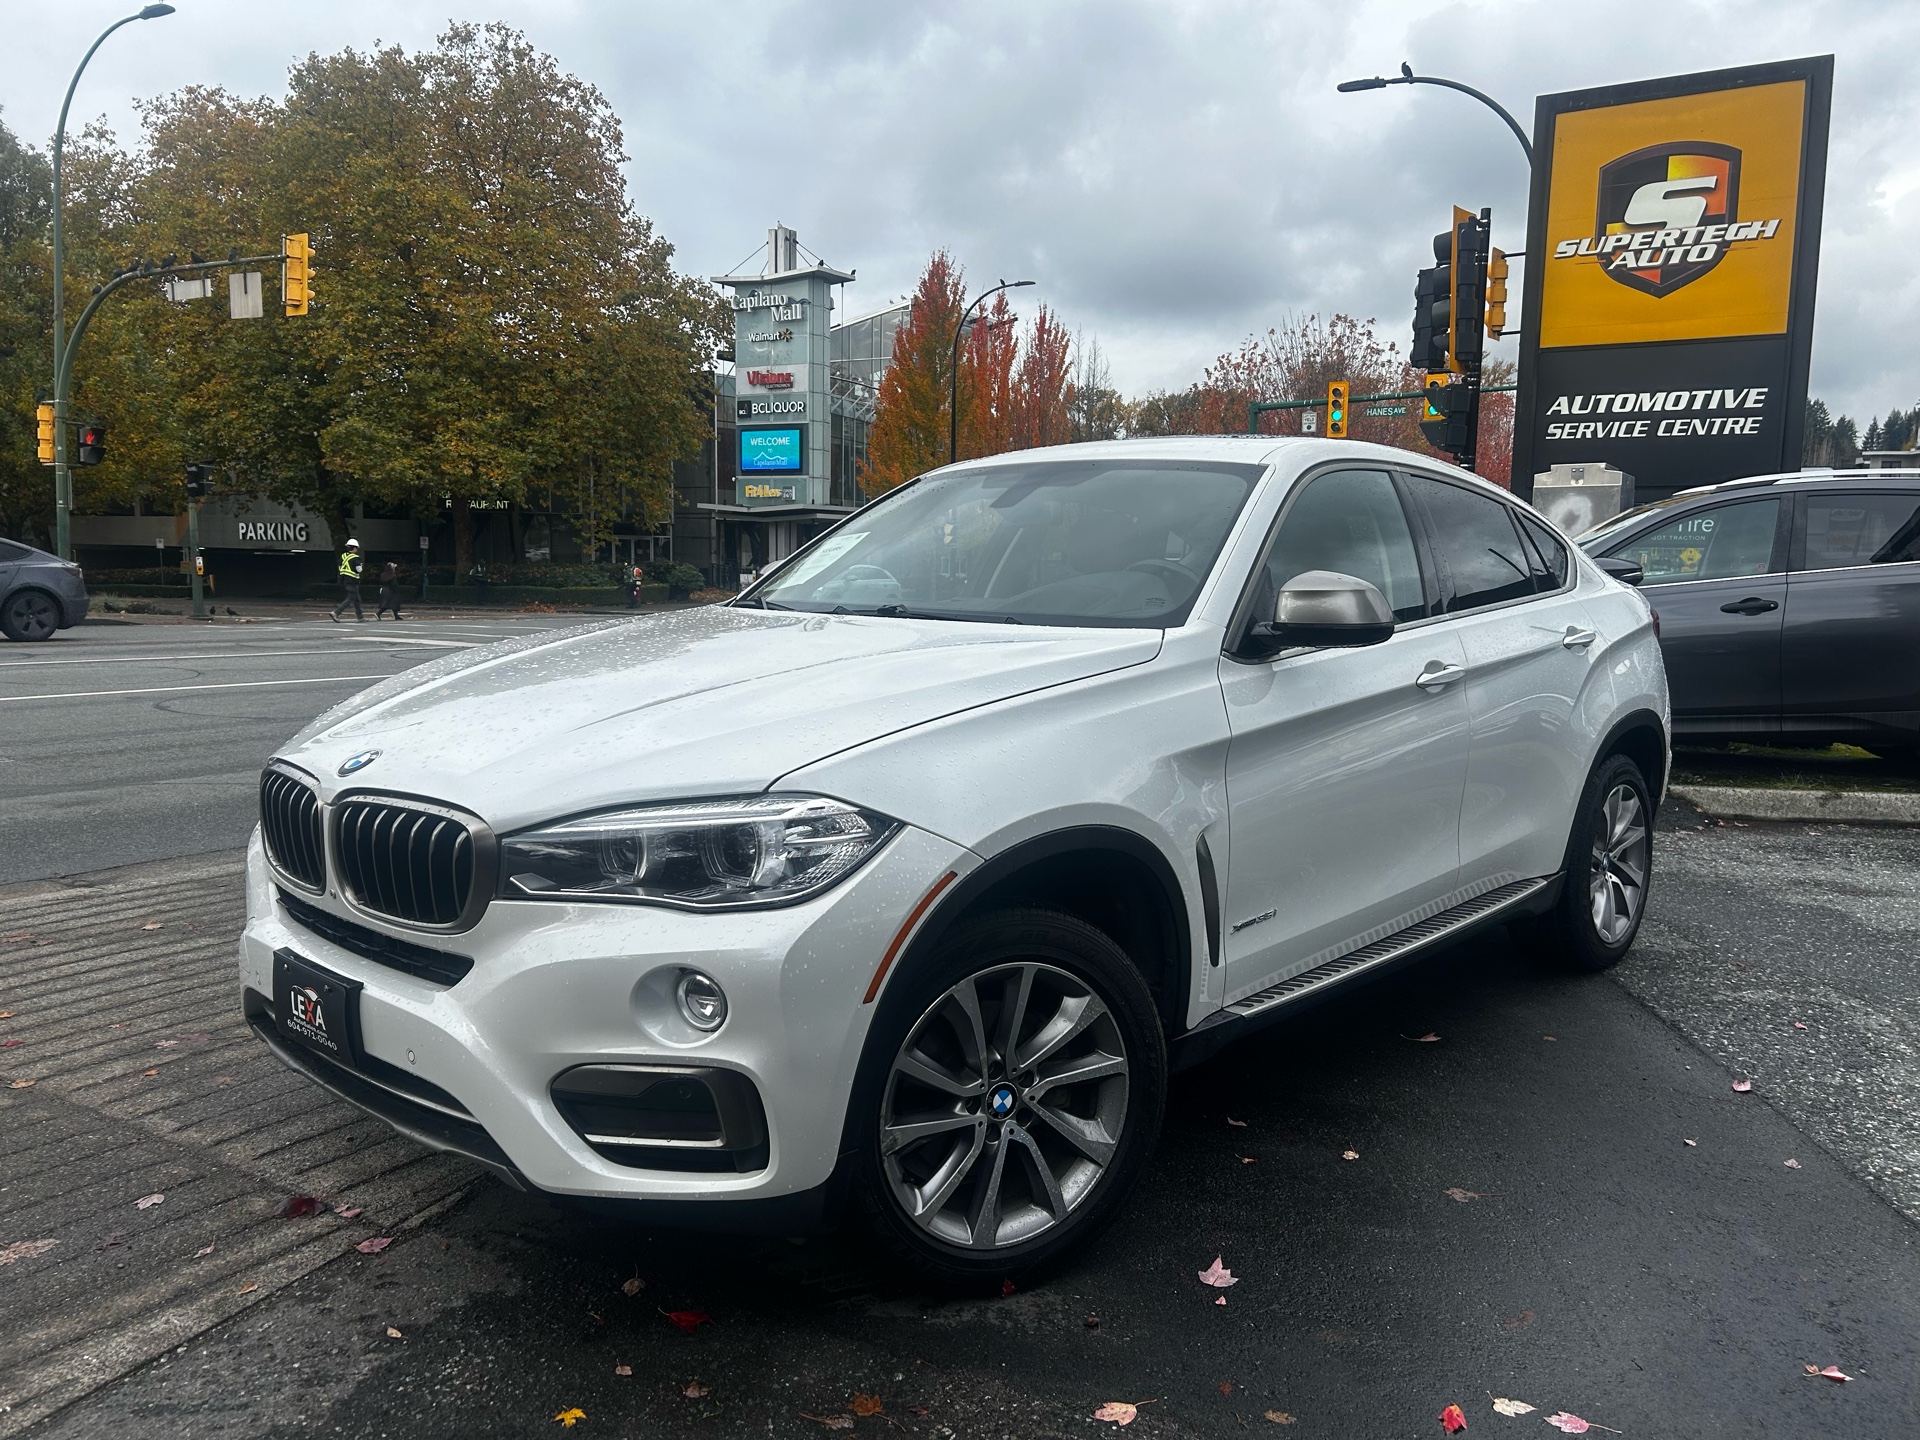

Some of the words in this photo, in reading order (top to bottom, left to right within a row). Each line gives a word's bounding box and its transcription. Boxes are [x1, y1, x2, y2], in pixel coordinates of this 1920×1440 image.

[1554, 218, 1783, 260] SUPERTECH
[1608, 244, 1718, 270] AUTO
[731, 291, 788, 313] Capilano
[770, 303, 802, 321] Mall
[748, 331, 780, 342] Walmart
[747, 370, 792, 385] Visions
[1367, 408, 1394, 416] HANES
[1545, 387, 1768, 416] AUTOMOTIVE
[1545, 420, 1651, 440] SERVICE
[1656, 416, 1764, 438] CENTRE
[750, 436, 790, 446] WELCOME
[238, 522, 308, 542] PARKING
[290, 990, 326, 1031] LEXA
